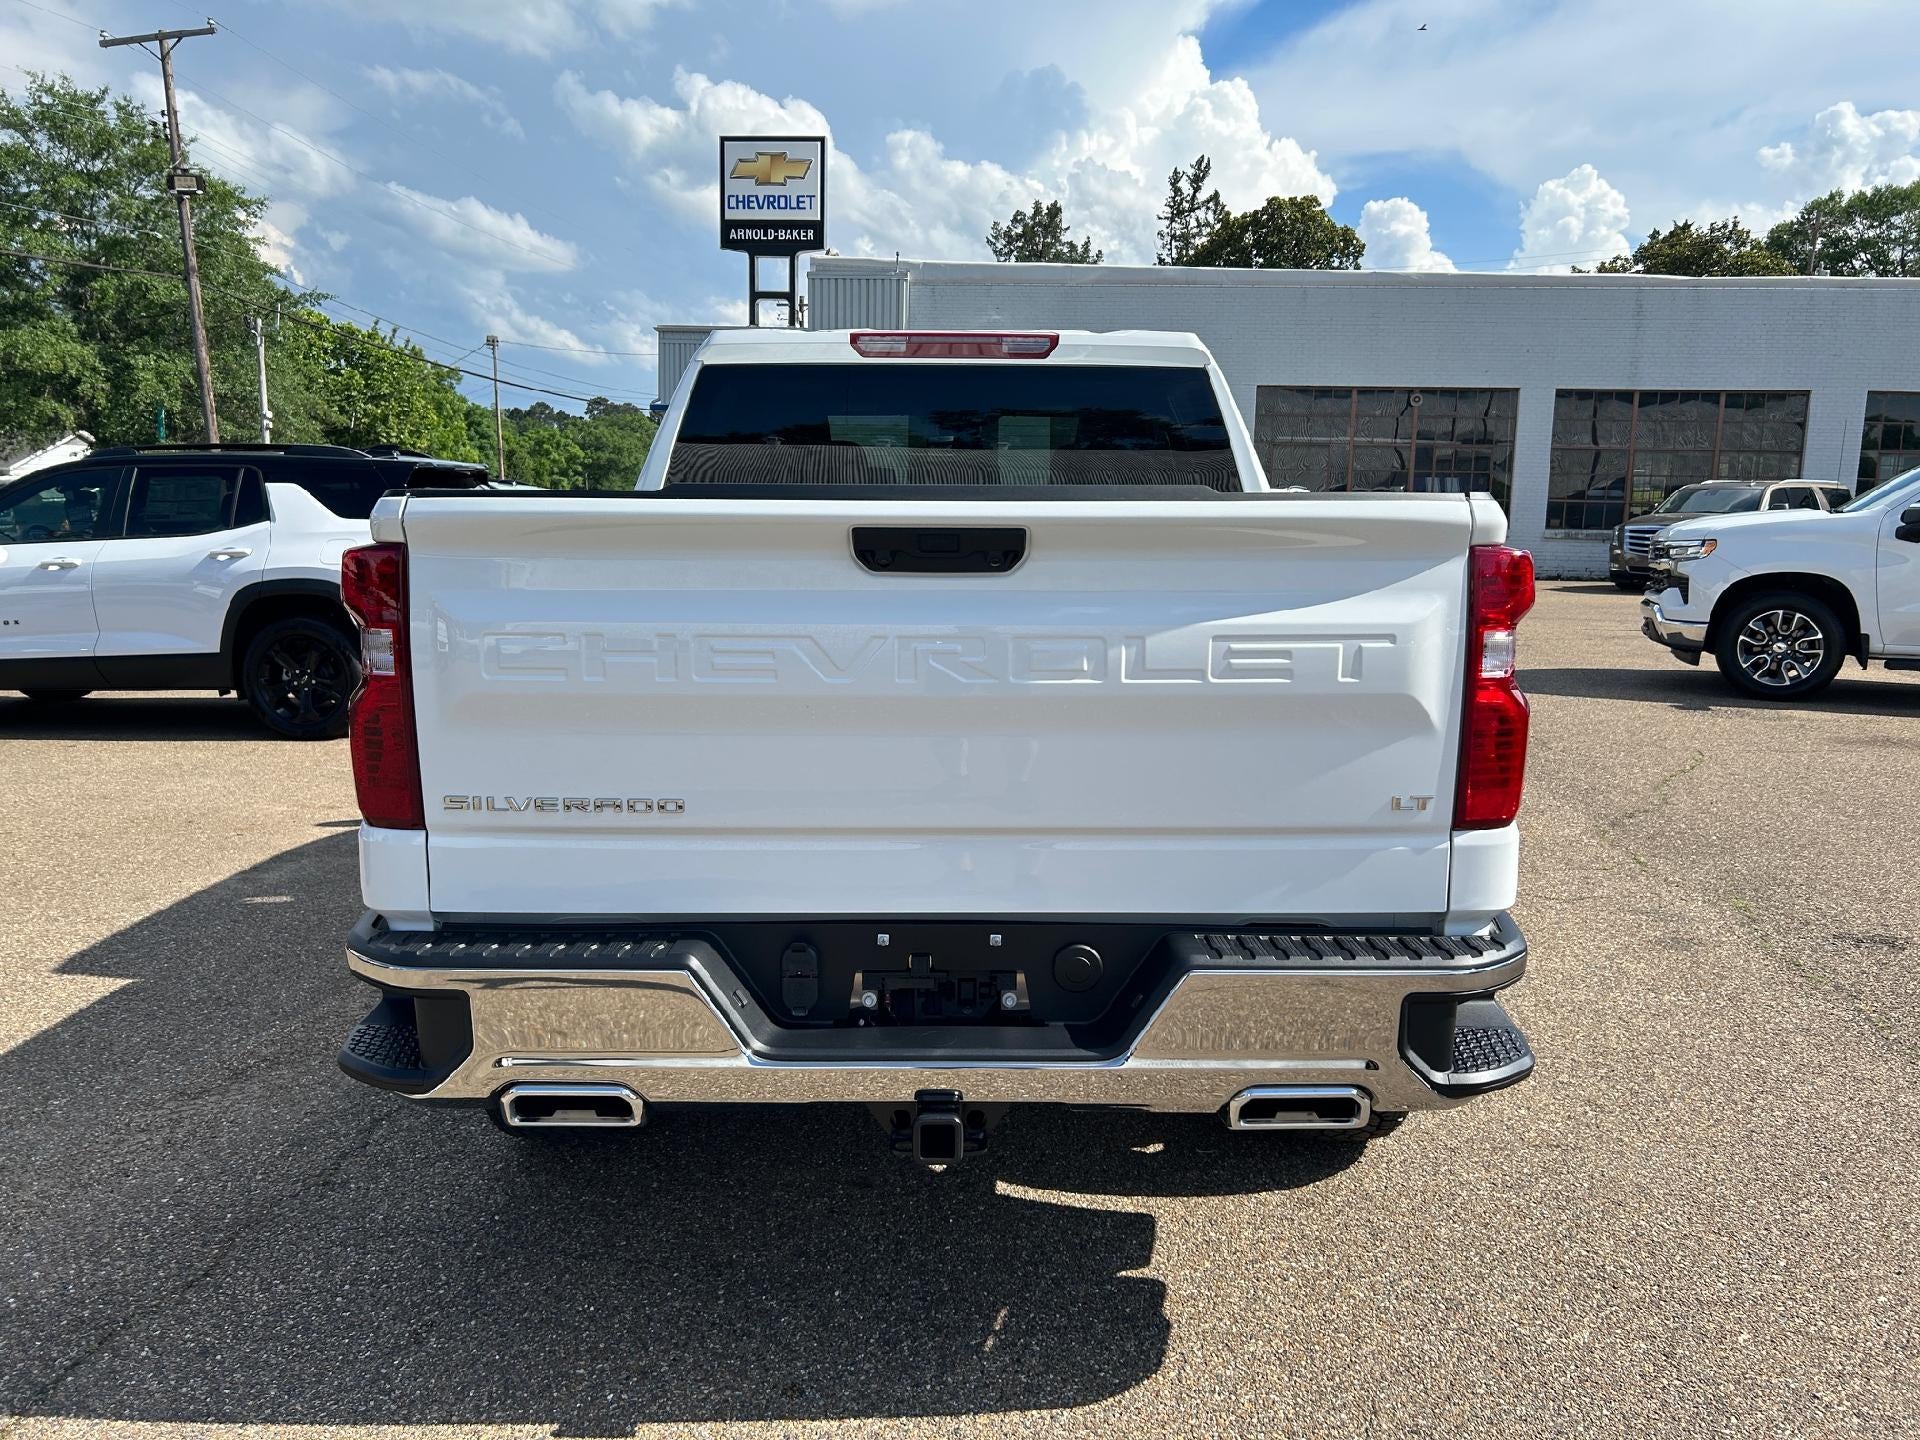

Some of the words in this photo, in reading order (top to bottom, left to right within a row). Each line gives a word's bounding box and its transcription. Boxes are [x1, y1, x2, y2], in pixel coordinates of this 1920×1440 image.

[727, 194, 816, 210] CHEVROLET
[729, 228, 814, 240] ARNOLD-BAKER
[480, 632, 1397, 684] CHEVROLET
[442, 794, 686, 814] SILVERADO
[1391, 795, 1435, 811] LT
